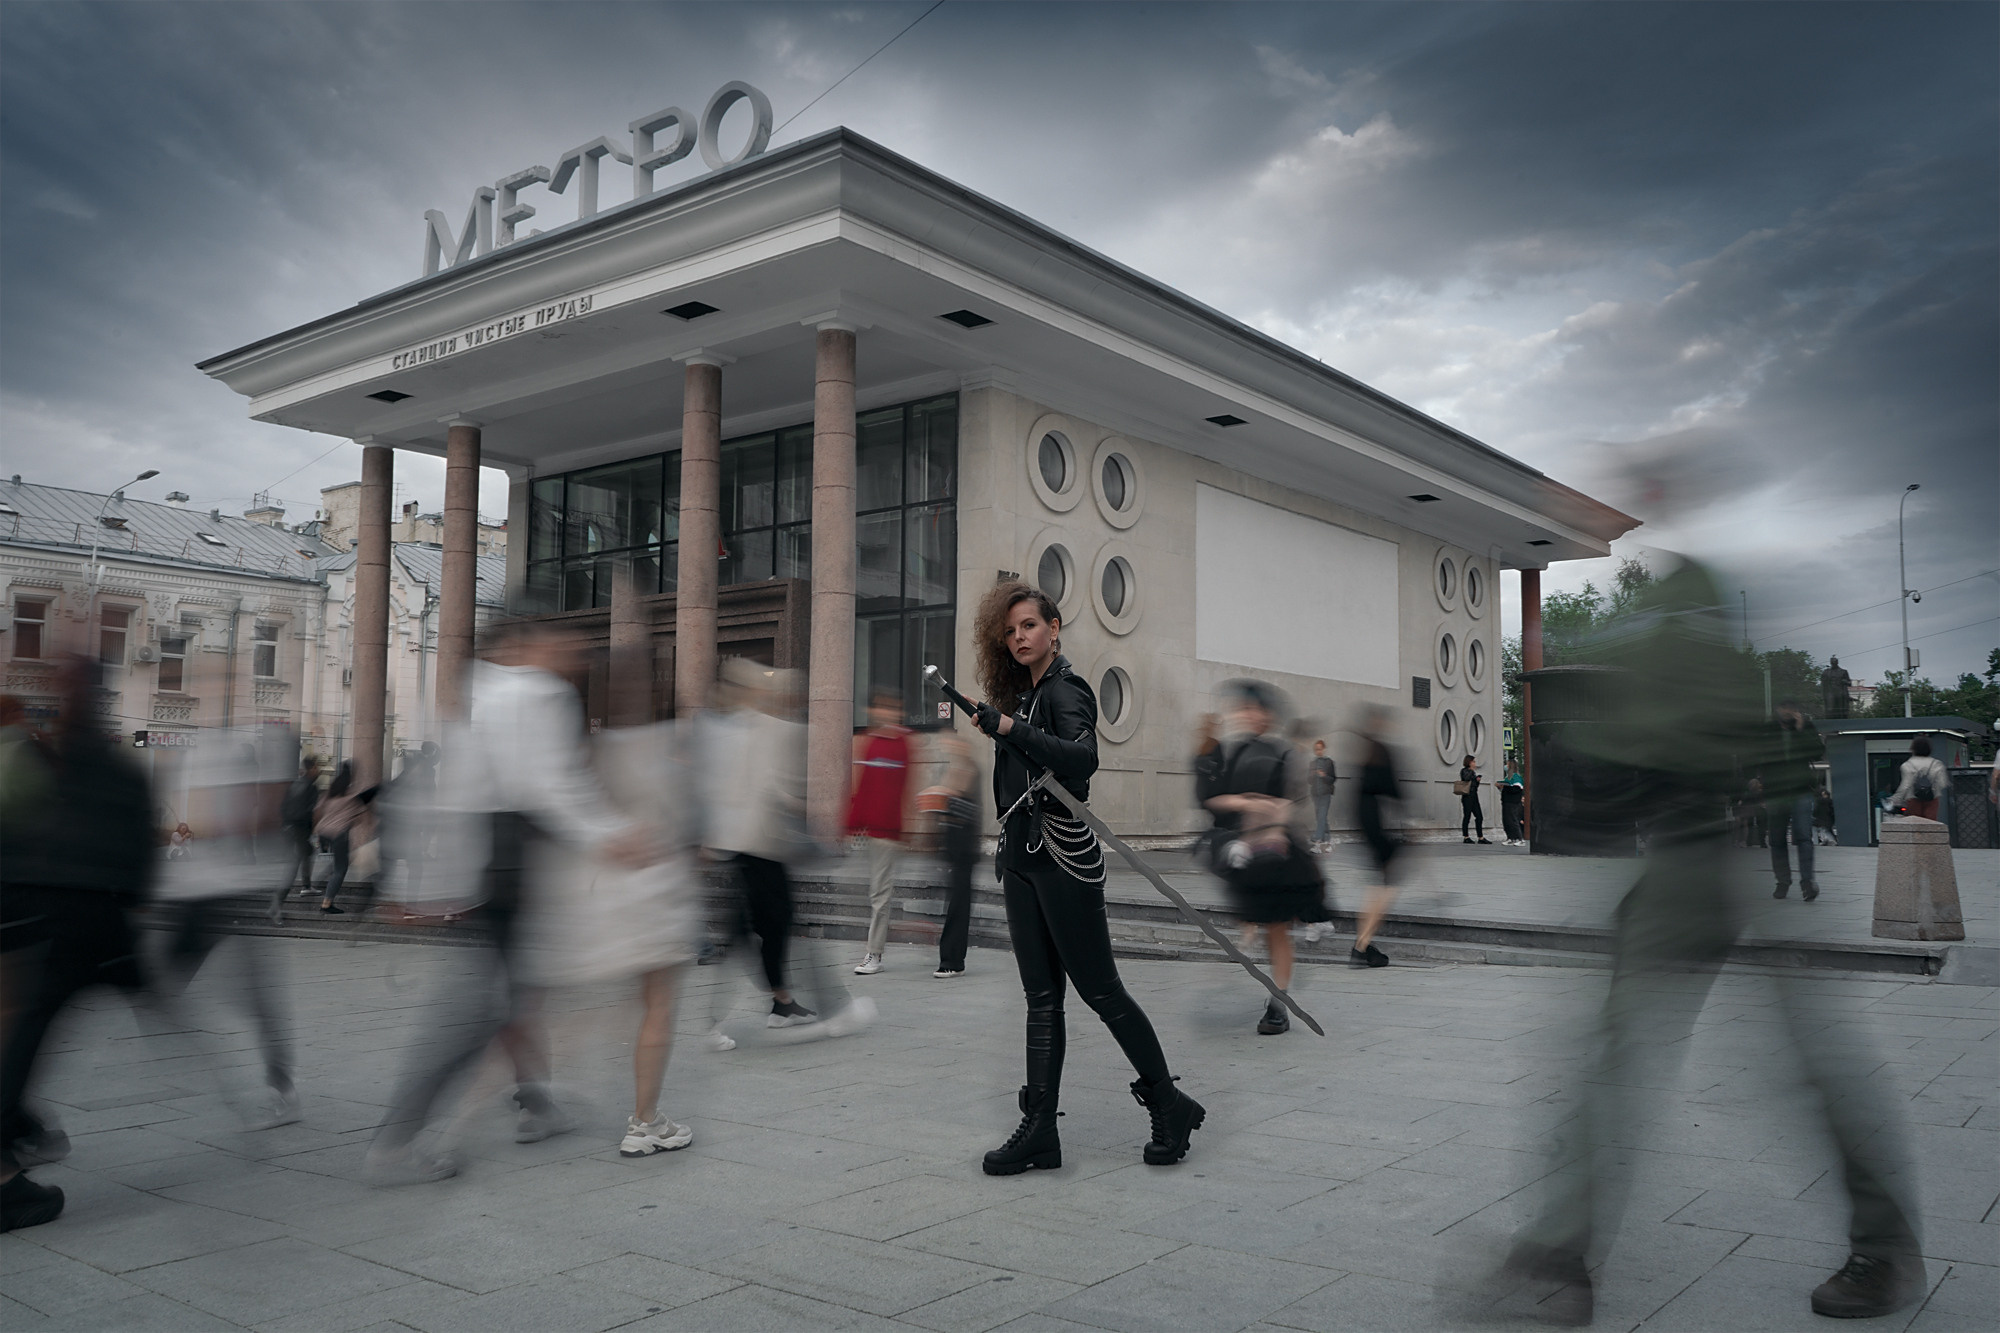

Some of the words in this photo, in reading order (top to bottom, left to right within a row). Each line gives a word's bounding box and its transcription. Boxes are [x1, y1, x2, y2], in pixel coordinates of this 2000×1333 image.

[423, 80, 773, 277] МЕТРО
[392, 337, 457, 370] СТАНЦИЯ
[465, 315, 526, 347] ЧИСТЫЕ
[535, 295, 593, 326] ПРУДЫ
